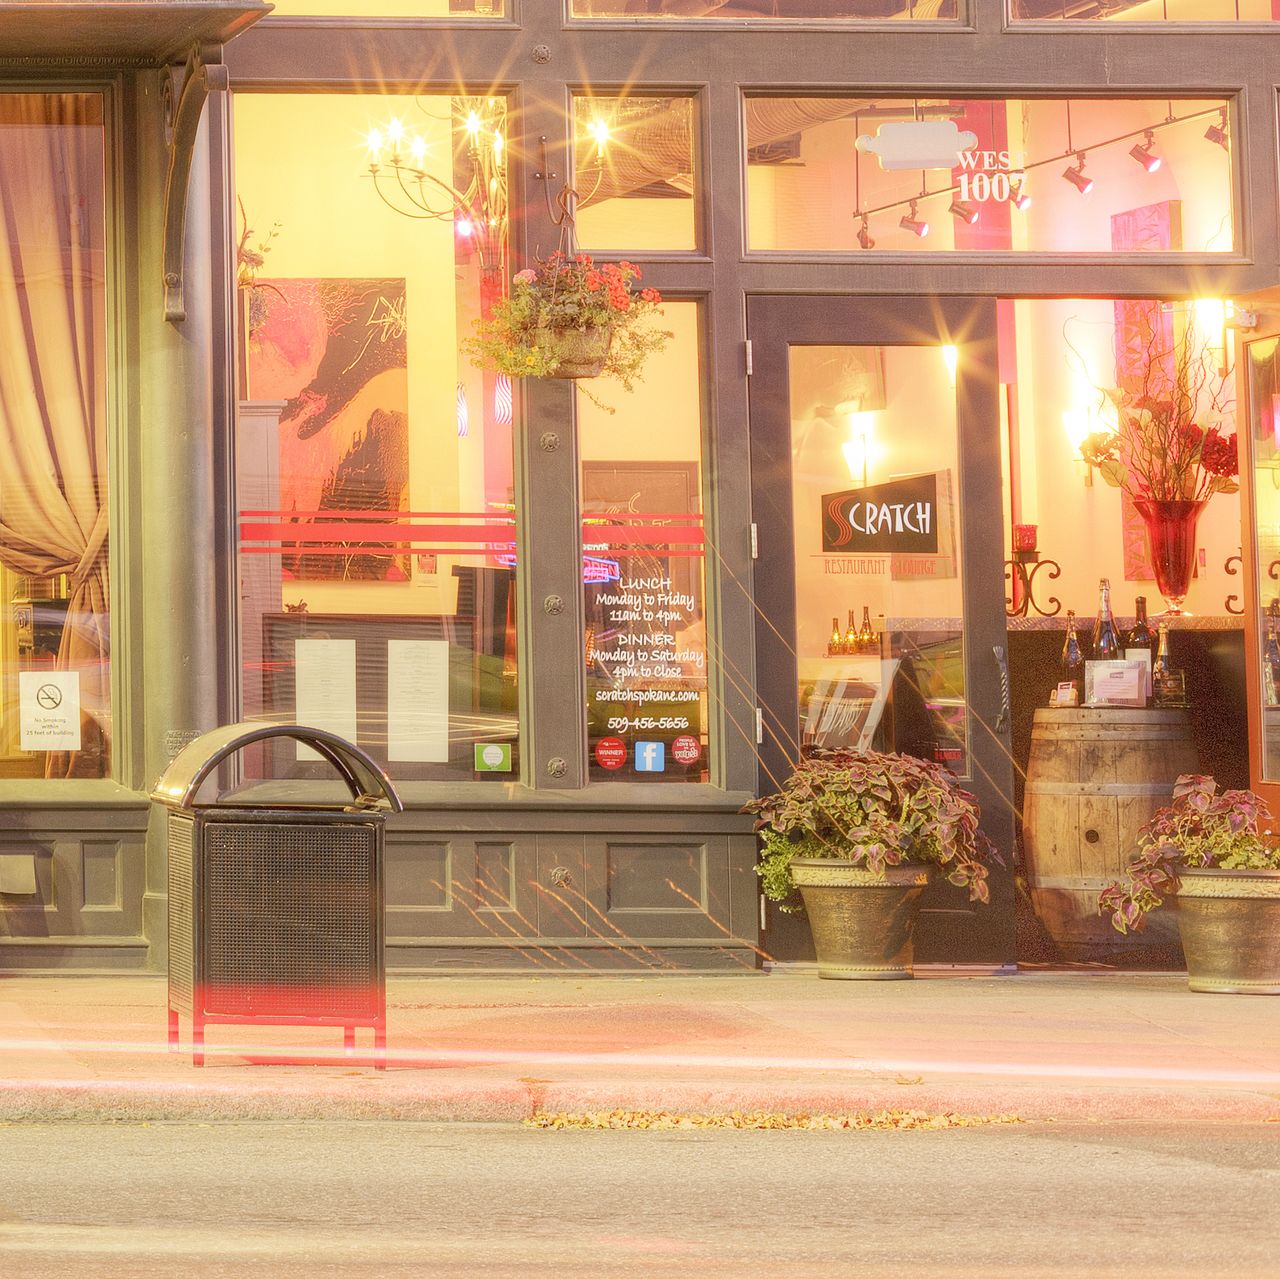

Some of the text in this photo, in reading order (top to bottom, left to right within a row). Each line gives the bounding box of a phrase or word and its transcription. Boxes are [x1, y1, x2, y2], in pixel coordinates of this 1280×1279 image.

[956, 150, 1028, 170] WEST
[956, 172, 1028, 202] 1007
[828, 495, 931, 547] SCRATCH
[824, 559, 886, 575] RESTAURANT
[619, 577, 672, 591] LUNCH
[596, 592, 695, 612] Monday to Friday
[609, 610, 682, 626] 11am to 4pm
[618, 634, 676, 646] DINNER
[589, 648, 704, 668] Monday to Saturday
[612, 665, 682, 682] 4pm to Close
[595, 688, 700, 706] scratchspokane.com
[607, 716, 689, 733] 509-456-5656
